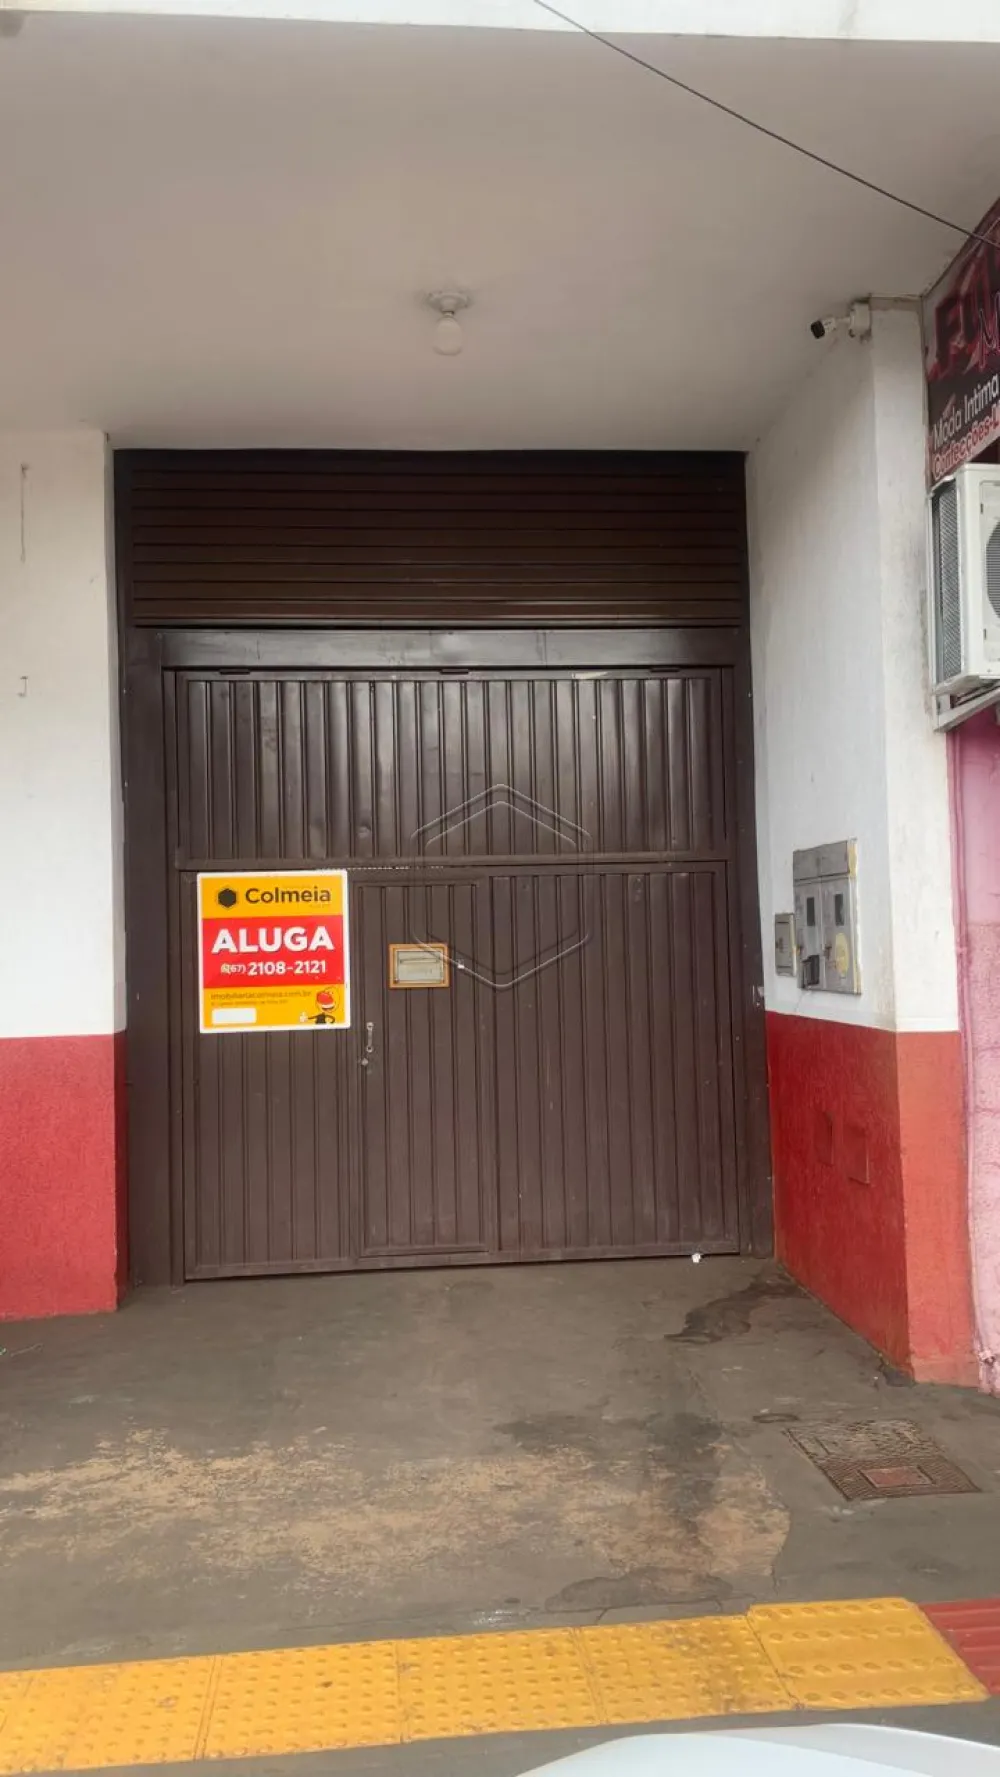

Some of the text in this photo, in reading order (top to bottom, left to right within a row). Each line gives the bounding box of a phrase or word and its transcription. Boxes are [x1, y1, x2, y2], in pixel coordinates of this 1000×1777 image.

[933, 373, 1000, 451] Moda Intima
[245, 886, 331, 904] Colmeia
[211, 926, 335, 954] ALUGA
[248, 960, 327, 976] 2108-2121
